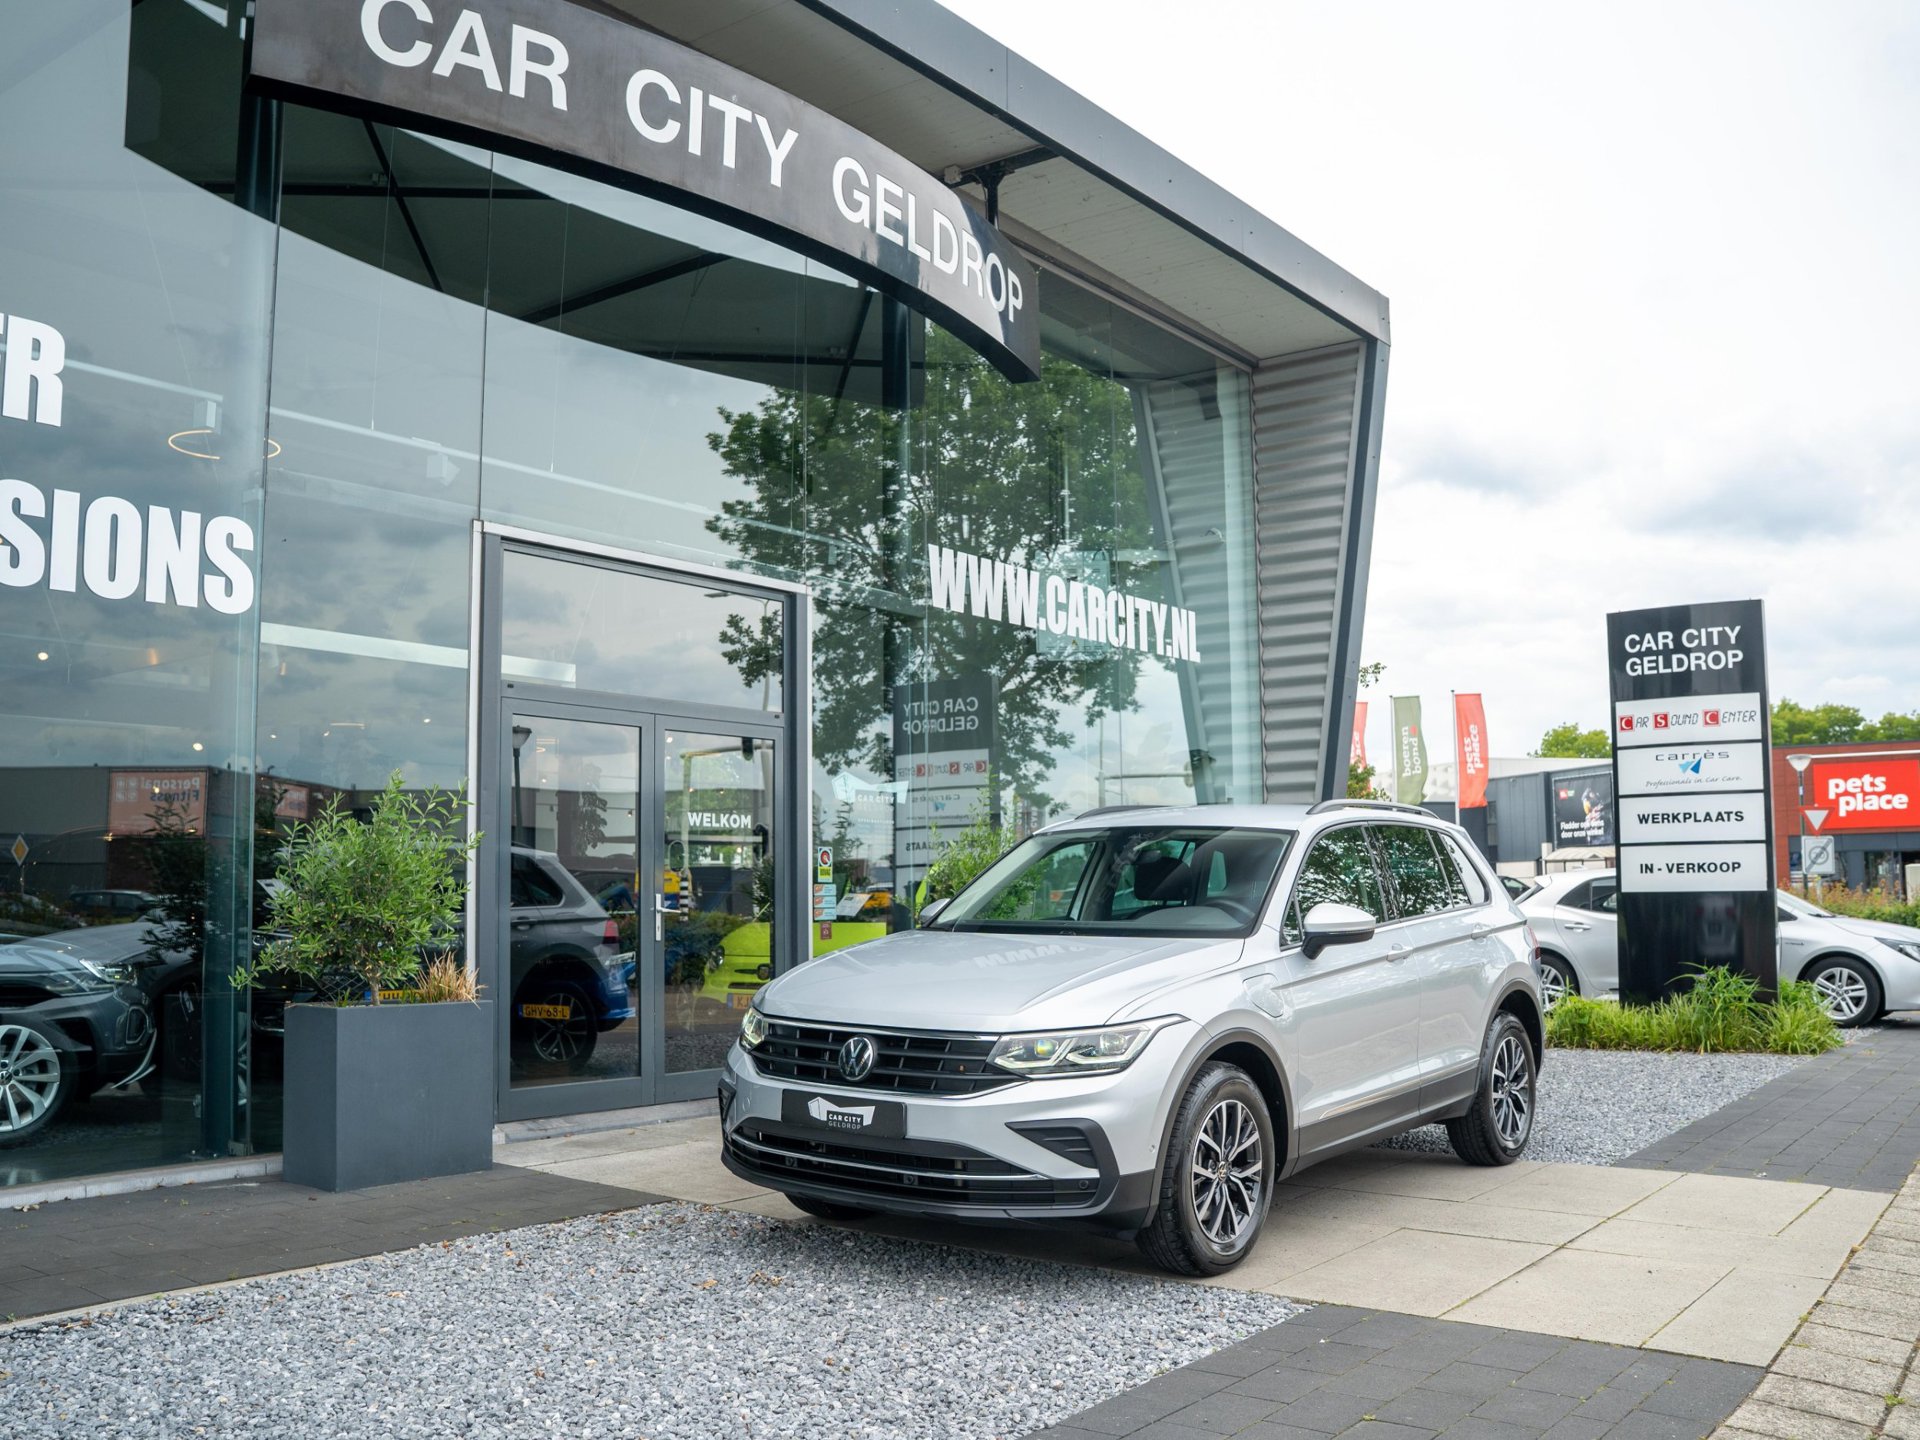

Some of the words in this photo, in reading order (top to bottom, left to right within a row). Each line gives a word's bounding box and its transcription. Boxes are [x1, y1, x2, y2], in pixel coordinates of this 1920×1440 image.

[360, 0, 570, 112] CAR
[625, 68, 800, 189] CITY
[832, 156, 1024, 324] GELDROP
[0, 478, 255, 615] SIONS
[927, 543, 1201, 664] WWW.CARCITY.NL
[1624, 630, 1675, 654] CAR
[1681, 625, 1742, 648] CITY
[1625, 649, 1744, 677] GELDROP
[1703, 708, 1757, 728] CENTER
[1401, 726, 1411, 778] boeren
[1409, 736, 1422, 775] bond
[1464, 736, 1476, 775] pets
[1469, 724, 1484, 769] place
[1655, 749, 1730, 762] carrès
[1828, 773, 1887, 800] pets
[1637, 810, 1745, 825] WERKPLAATS
[1838, 793, 1909, 817] place
[687, 811, 752, 829] WELKOM
[1639, 863, 1654, 874] IN
[1665, 861, 1742, 874] VERKOOP
[828, 1113, 843, 1121] CAR
[844, 1114, 862, 1124] CITY
[828, 1120, 861, 1130] GELDROP
